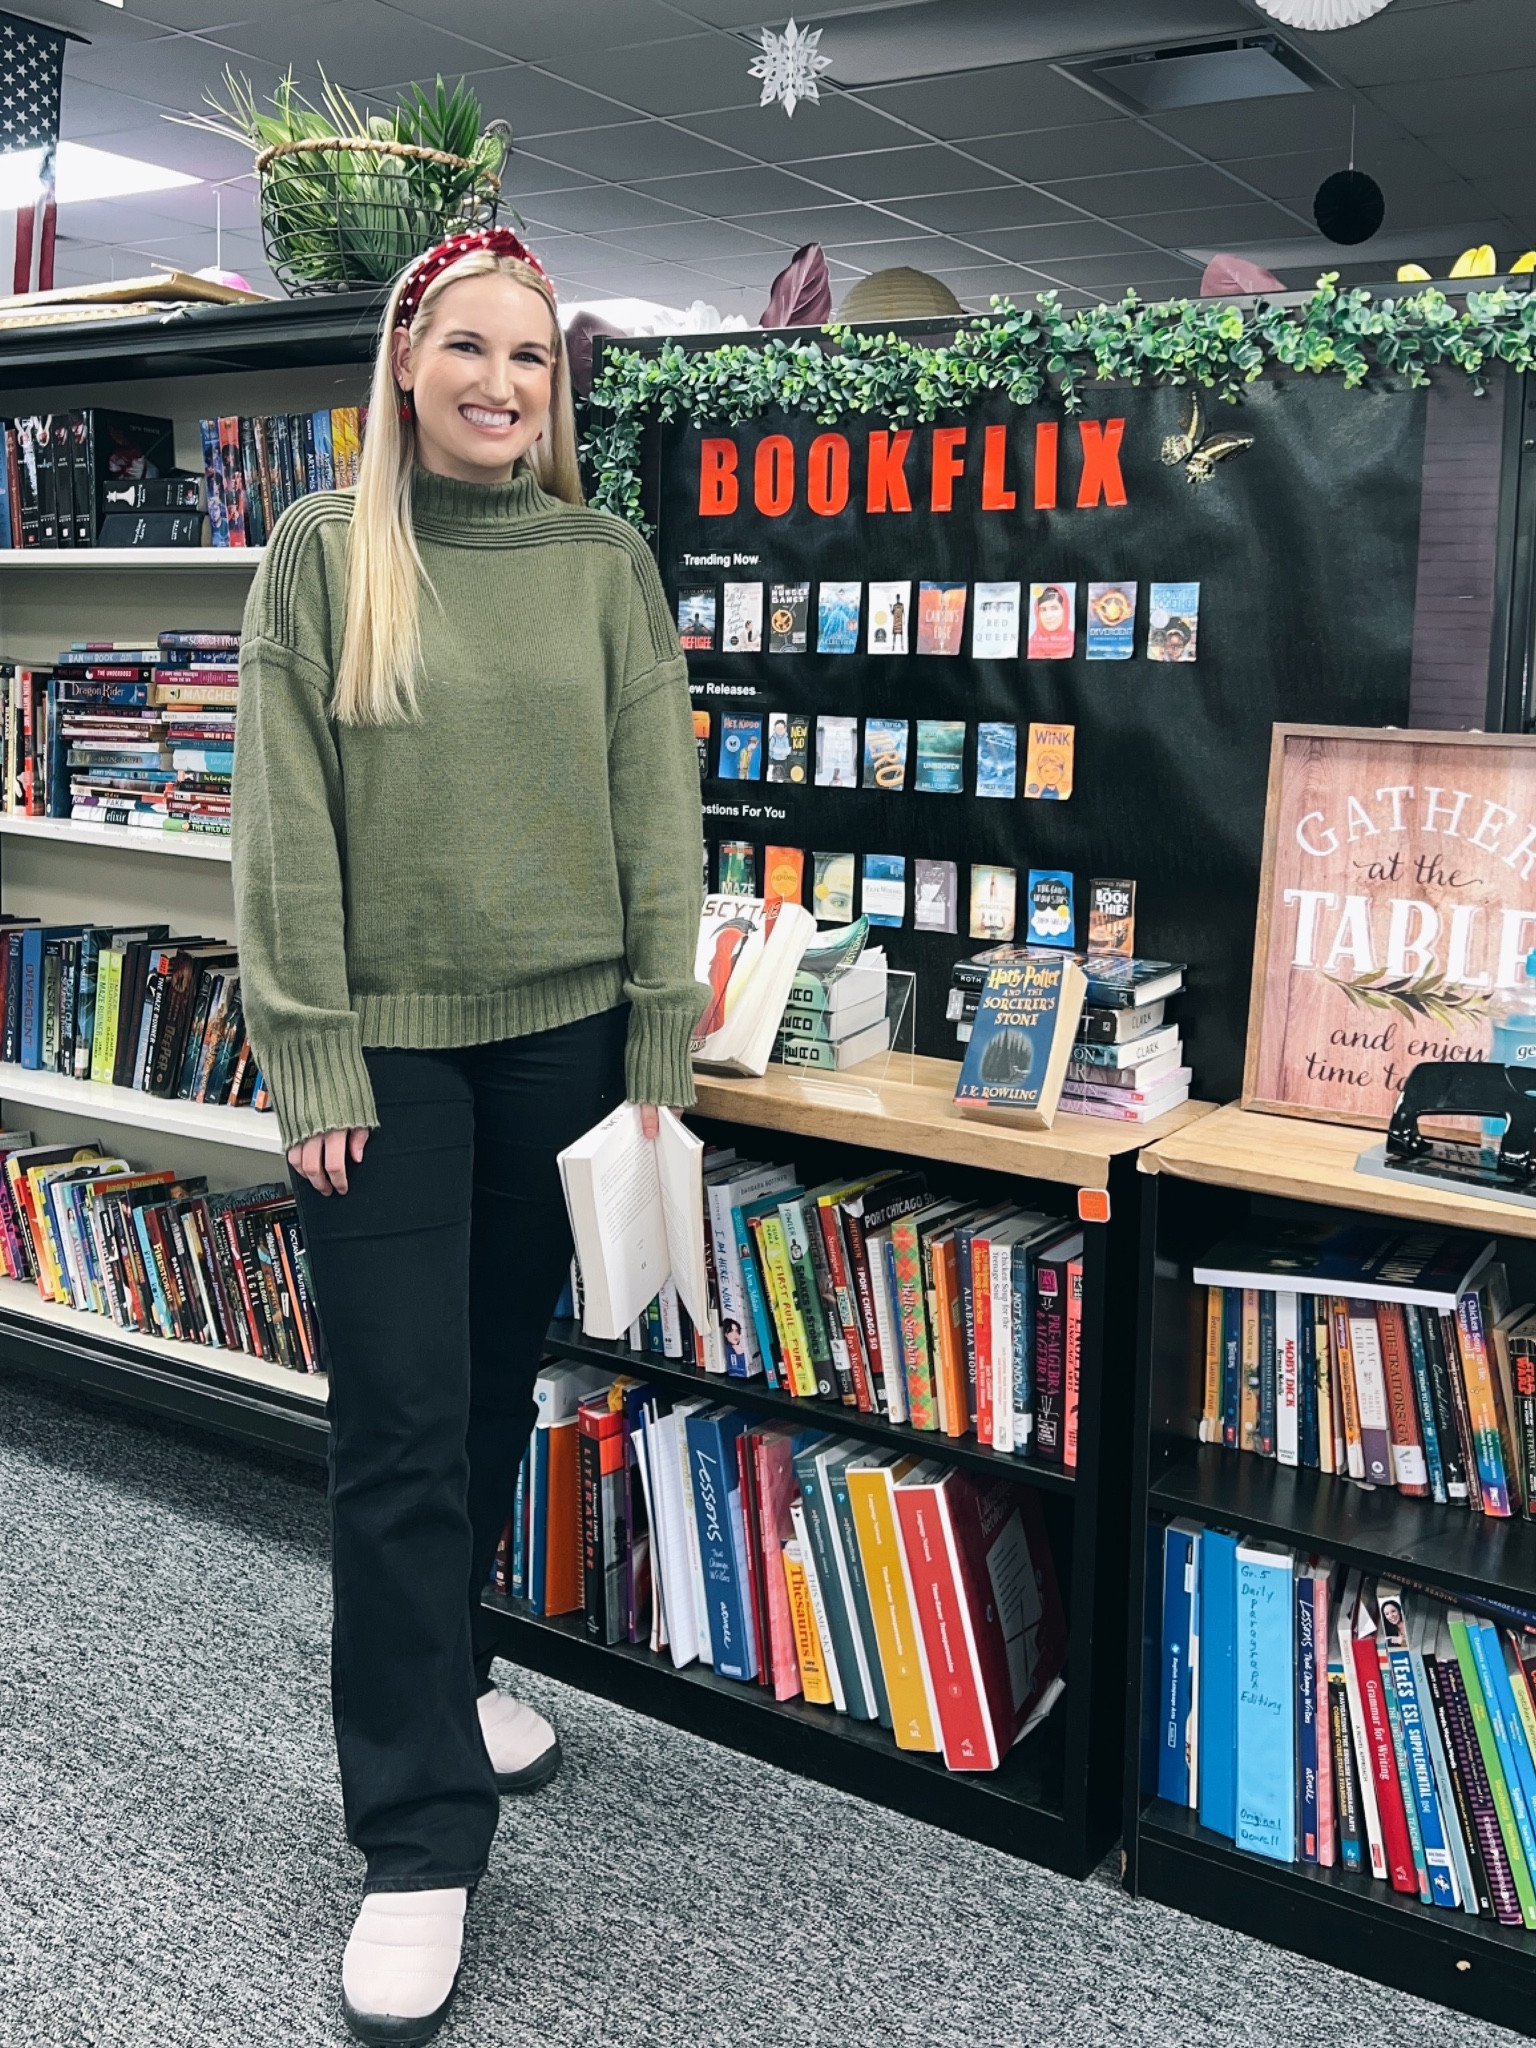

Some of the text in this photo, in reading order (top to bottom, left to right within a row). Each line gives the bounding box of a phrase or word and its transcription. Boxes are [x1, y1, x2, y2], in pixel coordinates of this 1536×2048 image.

[307, 453, 316, 490] ARTEMIS
[698, 418, 1128, 517] BOOKFLIX
[683, 553, 760, 568] Trending Now
[975, 633, 1017, 642] QUEEN
[69, 654, 113, 663] BAN BOOK
[72, 682, 125, 697] Dragon Rider
[184, 690, 238, 699] MATCHED
[706, 684, 756, 696] Releases
[1035, 730, 1070, 746] WINK
[106, 811, 127, 822] elixir
[205, 825, 221, 833] WILD
[742, 805, 786, 819] For You
[1353, 852, 1484, 887] at the
[721, 881, 755, 896] MAZE
[1096, 889, 1129, 902] BOOK
[702, 899, 781, 918] SCYTHE
[1097, 902, 1128, 916] THIEF
[1283, 888, 1536, 991] TABLE
[960, 975, 982, 984] ROTH
[988, 965, 1060, 993] Harry Potter
[1027, 989, 1043, 997] THE
[23, 963, 34, 1048] DIVERGENT
[45, 976, 56, 1057] INSURGENT
[153, 993, 162, 1013] MAZE
[983, 997, 1055, 1011] SORCERER'S
[994, 1012, 1039, 1026] STONE
[150, 1013, 159, 1044] RUNNER
[1131, 1012, 1153, 1030] CLARK
[1330, 1023, 1398, 1052] and
[157, 1024, 175, 1071] DEEPER
[1136, 1042, 1160, 1060] CLARK
[1305, 1052, 1372, 1087] time
[981, 1086, 1038, 1101] ROWLING
[0, 1193, 13, 1233] SPIN
[865, 1196, 923, 1229] PORT CHICAGO
[704, 1242, 712, 1273] ANNE
[242, 1252, 259, 1307] ILLEGAL
[257, 1281, 267, 1303] BLOOD
[295, 1274, 307, 1300] BUTLER
[716, 1241, 733, 1312] AM HERE NOW
[785, 1208, 820, 1355] FOWLER SNAKES STONES
[848, 1217, 878, 1349] SHEINKIN PORT CHICAGO 50
[992, 1251, 1000, 1300] Teenage Soul
[1000, 1251, 1010, 1329] Chicken Soup for the
[775, 1266, 793, 1327] FIRST RULE
[902, 1283, 918, 1371] Hello, Sunshine
[963, 1287, 974, 1346] ALABAMA
[1247, 1319, 1255, 1346] UNDER
[1458, 1301, 1472, 1351] Teenage Soul
[1012, 1292, 1024, 1410] NOT AS WE KNOW IT
[1037, 1322, 1047, 1383] ALGEBRA
[1209, 1315, 1219, 1357] Becoming
[1354, 1327, 1365, 1365] GIRLS
[1468, 1300, 1486, 1381] Chicken Soup for the
[790, 1339, 805, 1370] PUNK
[850, 1352, 863, 1389] McGraw
[967, 1351, 976, 1384] MOON
[1047, 1314, 1061, 1395] PRE-ALGEBRA
[1384, 1319, 1406, 1422] THE TRAITORS'
[1285, 1339, 1295, 1407] MOBY DICK
[1516, 1357, 1526, 1393] WARS
[1417, 1370, 1430, 1422] POEMS ENJOY
[1527, 1429, 1535, 1469] BETRAYAL
[584, 1449, 594, 1570] LITERATURE
[695, 1450, 723, 1543] Lessons
[1240, 1565, 1271, 1580] Gr. 5
[915, 1509, 955, 1673] Language Time-Saver Transparencies
[1240, 1583, 1275, 1604] Daily
[1487, 1599, 1515, 1612] GRADES
[791, 1566, 810, 1657] Thesaurus
[808, 1574, 832, 1655] THIS SAME SKY
[882, 1565, 903, 1656] Time-Saver Transparencies
[1299, 1600, 1314, 1724] Lessons That Change Writers
[1481, 1671, 1494, 1698] Language
[1239, 1690, 1283, 1716] Editing
[1338, 1691, 1347, 1733] NAVIGATING
[1517, 1689, 1530, 1720] Gretchen
[1366, 1680, 1392, 1781] Grammar for Writing
[1393, 1657, 1432, 1798] TExES ESL SUPPLEMENTAL
[1333, 1706, 1347, 1816] COMMON CORE STATE STANDARDS
[1341, 1749, 1350, 1777] ENGLISH
[1344, 1778, 1353, 1814] LANGUAGE
[1390, 1723, 1407, 1777] UNSTOPPABLE
[1400, 1780, 1412, 1814] WRITING
[1407, 1817, 1420, 1851] TEACHER
[1512, 1787, 1524, 1820] Spelling
[1240, 1808, 1282, 1830] Original
[1494, 1778, 1509, 1821] Vocabulary
[1504, 1823, 1520, 1861] Workshop
